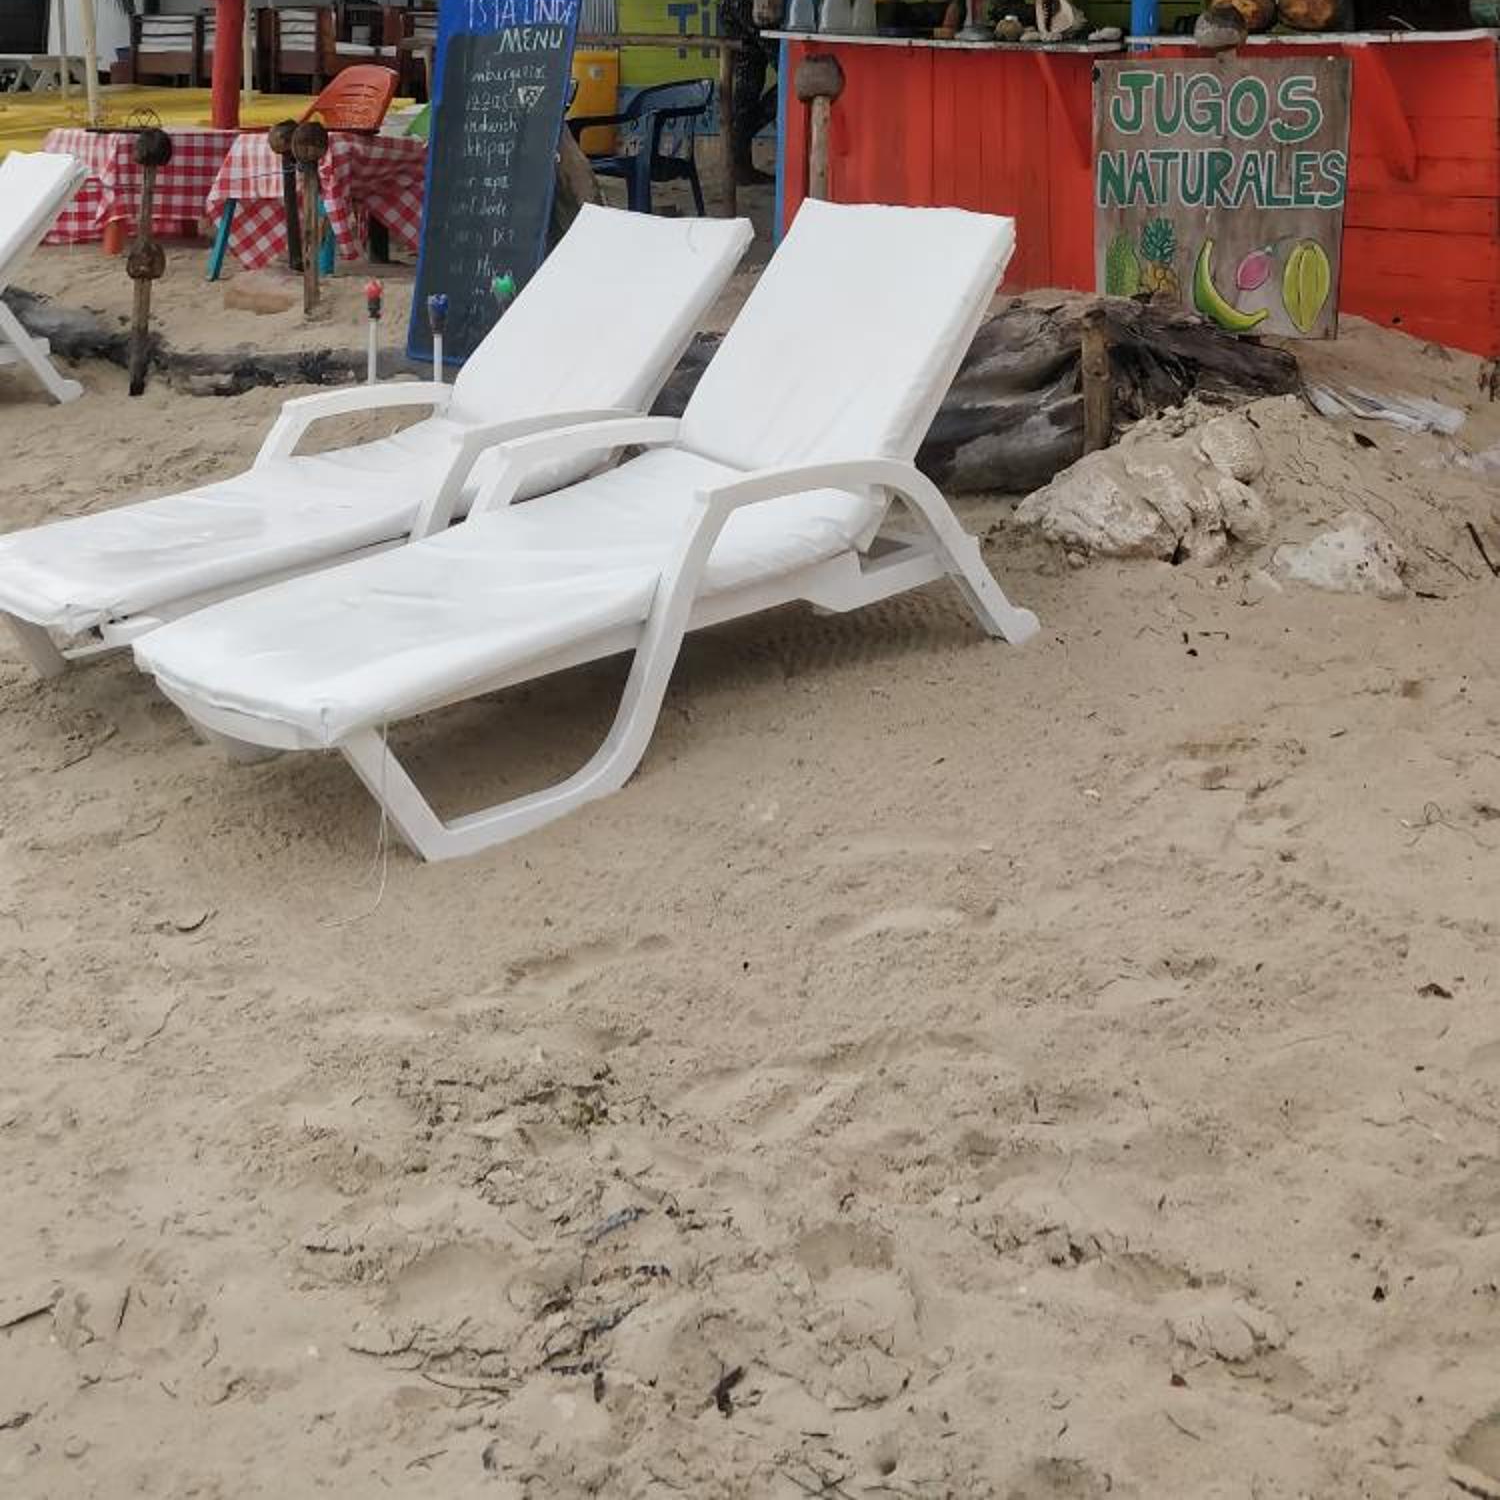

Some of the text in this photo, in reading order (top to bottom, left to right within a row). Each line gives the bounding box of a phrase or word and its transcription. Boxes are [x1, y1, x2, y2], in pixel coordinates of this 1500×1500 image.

[497, 27, 563, 54] MENU
[1110, 70, 1324, 143] JUGOS
[1098, 148, 1347, 210] NATURALES
